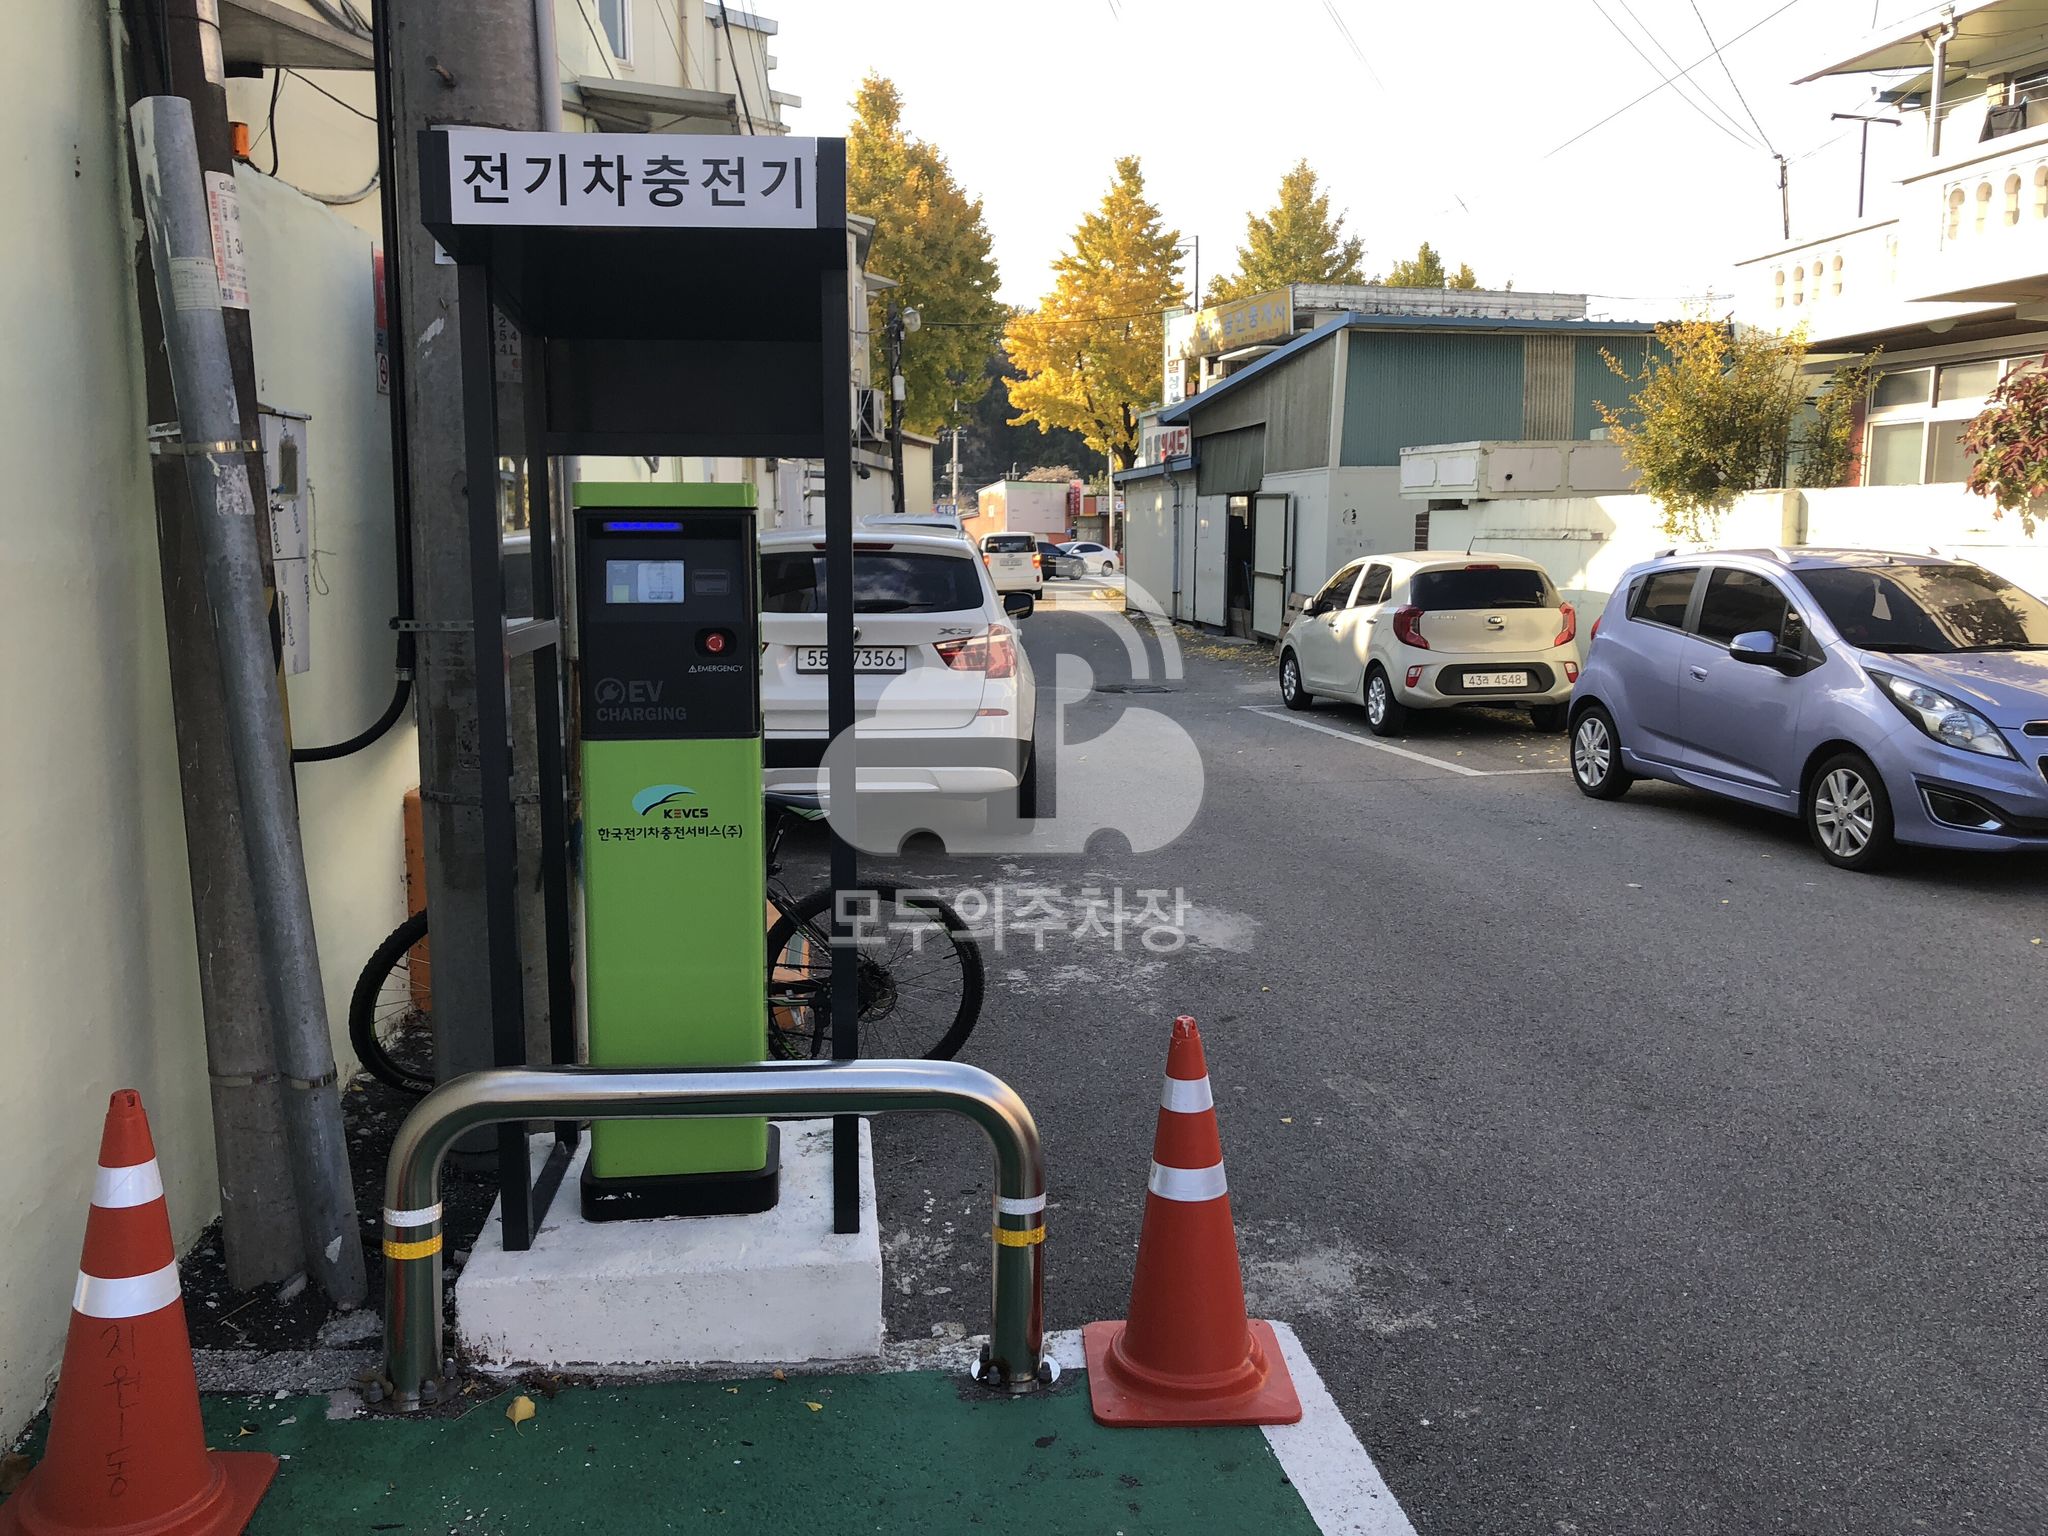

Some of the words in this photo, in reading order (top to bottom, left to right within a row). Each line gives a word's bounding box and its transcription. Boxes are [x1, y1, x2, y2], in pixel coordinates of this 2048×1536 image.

[463, 152, 803, 208] 전기차충전기
[806, 650, 828, 667] 55
[854, 650, 896, 667] 7356
[697, 664, 743, 673] EMERGENCY
[1494, 674, 1522, 685] 4548
[629, 680, 664, 703] EV
[596, 706, 687, 721] CHARGING
[663, 808, 709, 819] KEVCS
[597, 825, 743, 842] 한국전기차충전서비스(주)
